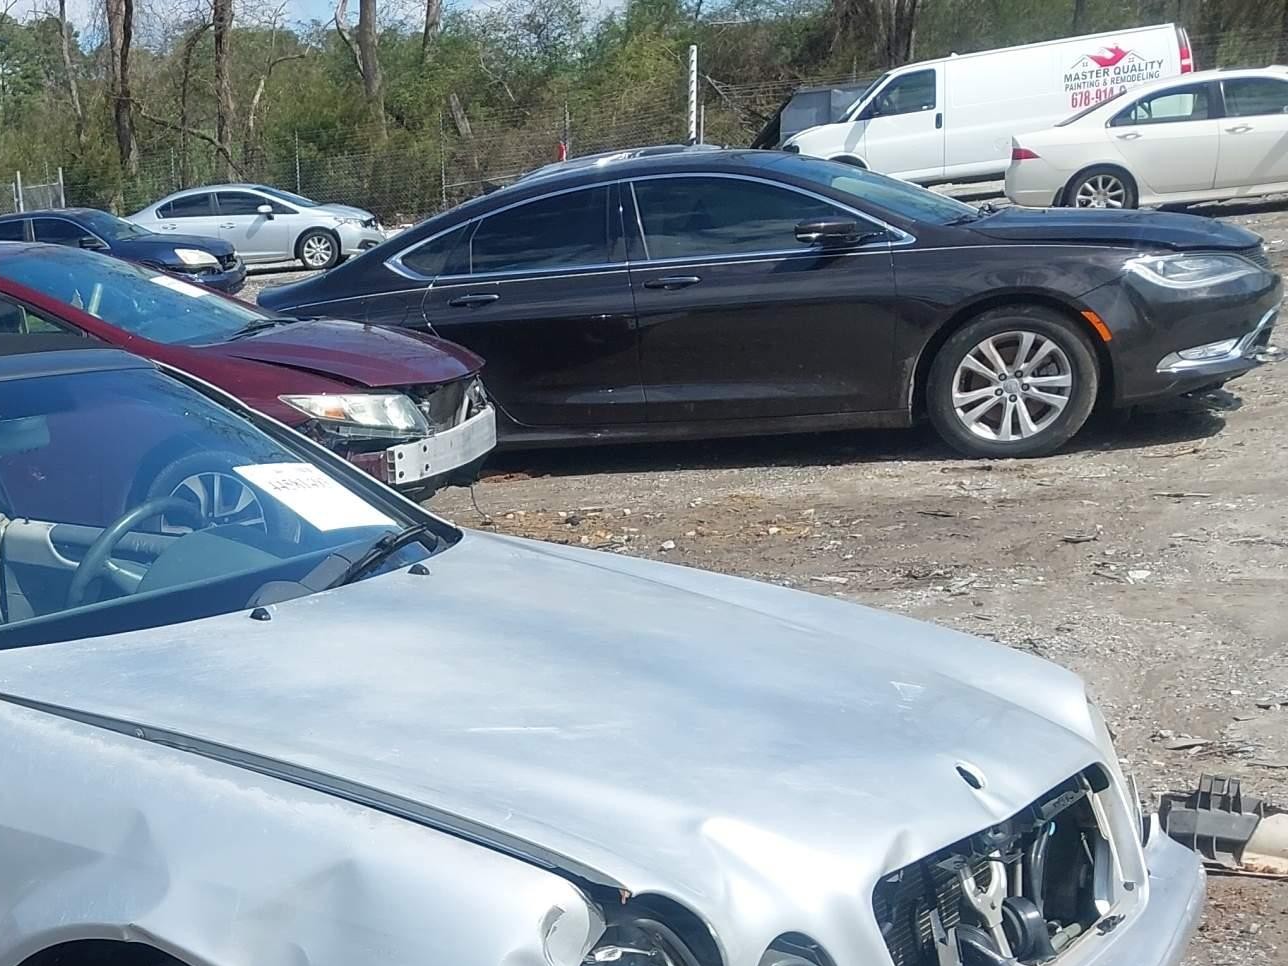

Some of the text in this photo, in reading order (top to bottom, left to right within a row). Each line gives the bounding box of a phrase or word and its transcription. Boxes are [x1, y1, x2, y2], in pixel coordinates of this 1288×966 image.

[1064, 59, 1164, 83] MASTER QUALITY
[1065, 70, 1160, 92] PAINTING & REMODELING
